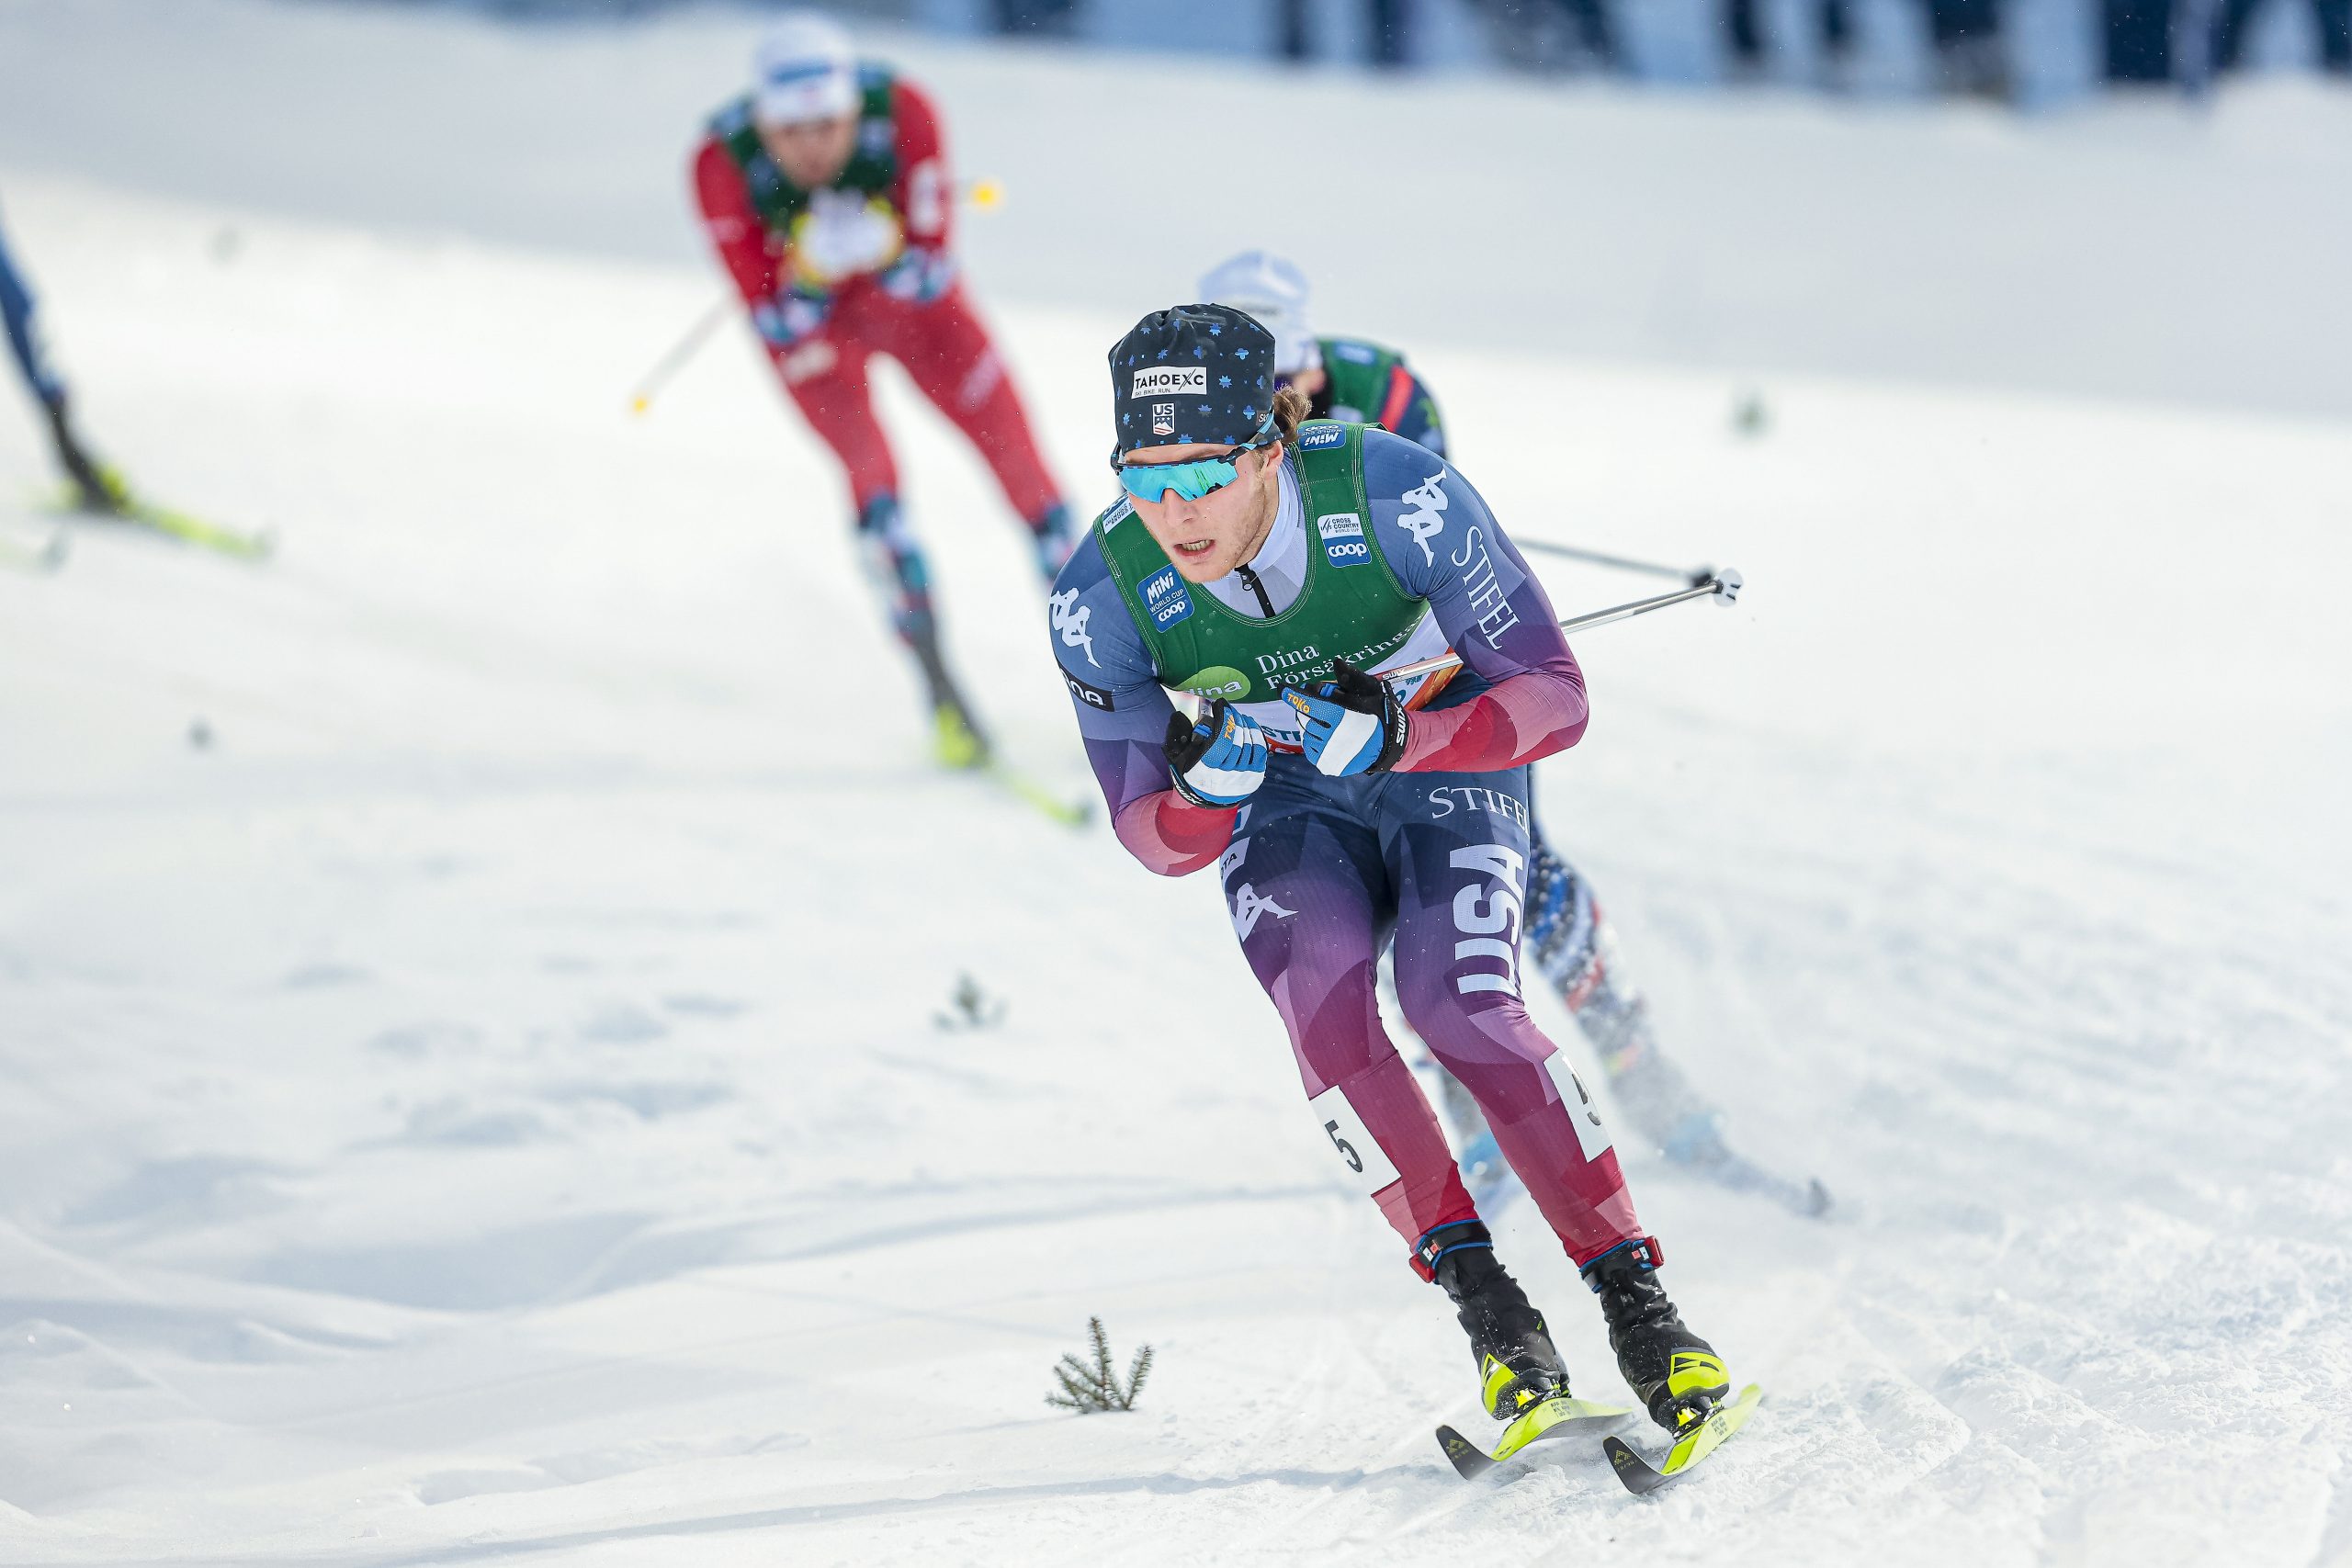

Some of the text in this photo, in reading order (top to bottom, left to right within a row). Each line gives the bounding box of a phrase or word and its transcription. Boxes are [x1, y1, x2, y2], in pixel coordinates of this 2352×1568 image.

[1136, 368, 1204, 390] TAHOEXC
[1154, 405, 1173, 415] US
[1328, 543, 1367, 557] coop
[1451, 525, 1521, 649] STIFEL
[1150, 588, 1184, 613] WORLD CUP
[1158, 601, 1185, 622] coop
[1255, 645, 1320, 675] Dina
[1450, 843, 1523, 995] USA
[1324, 1119, 1363, 1173] 5
